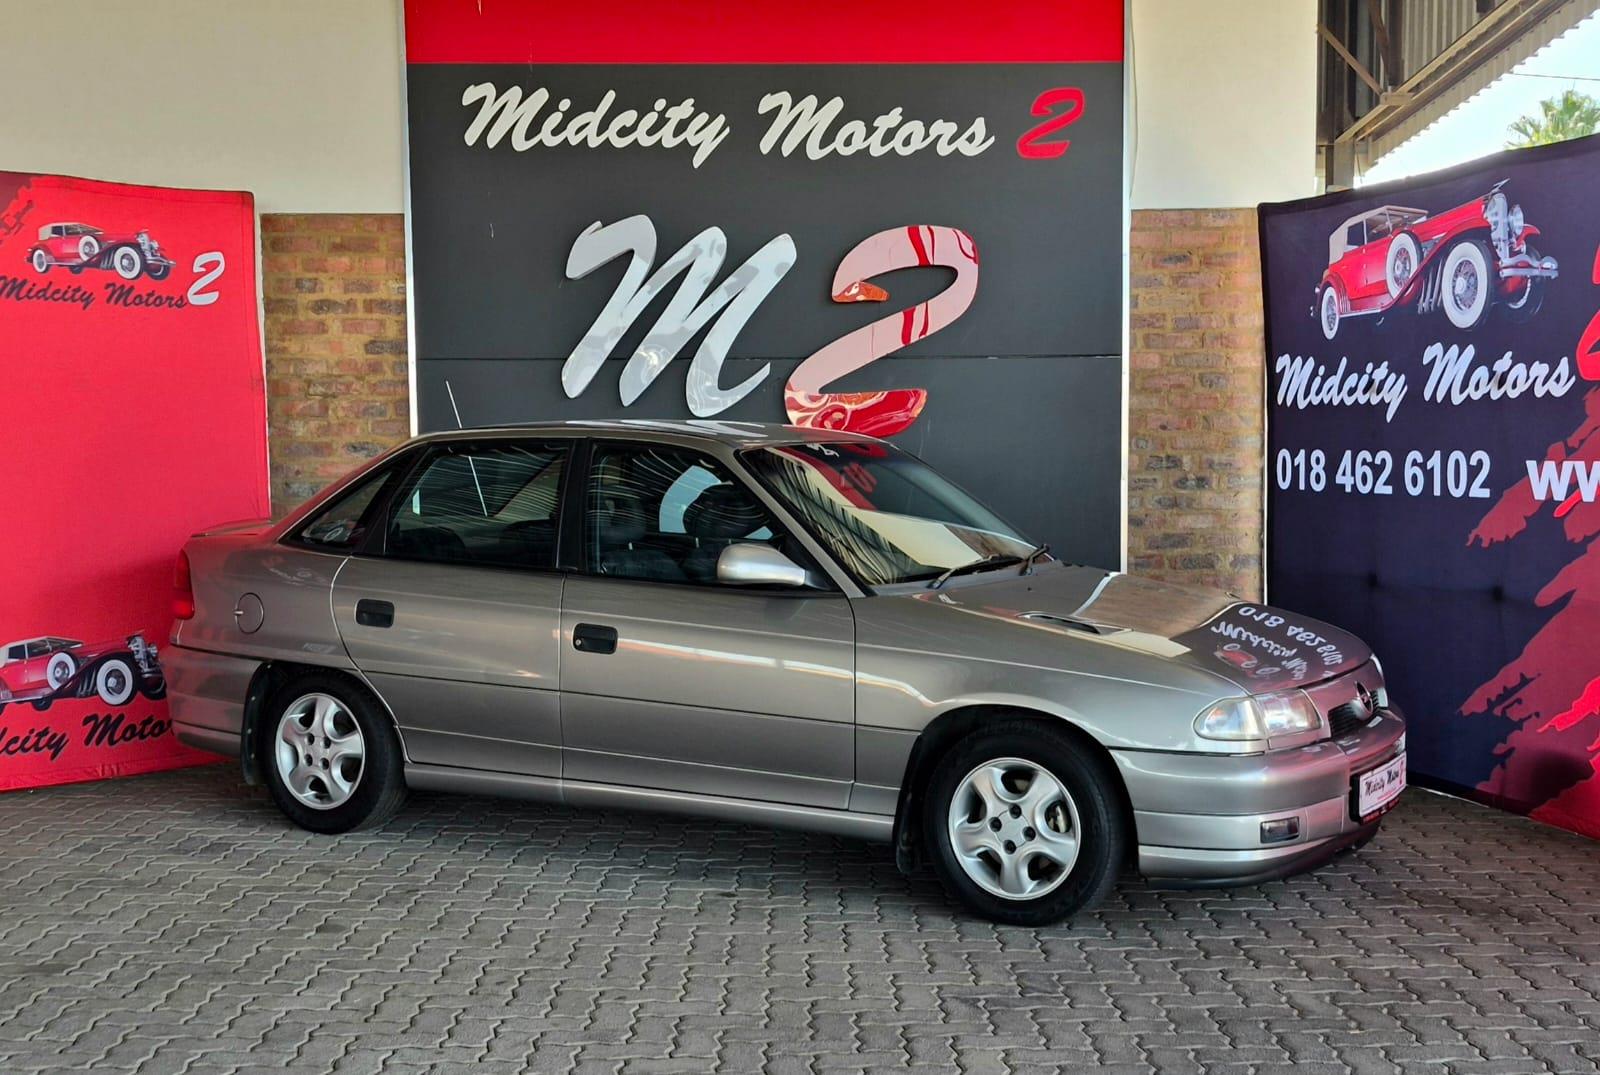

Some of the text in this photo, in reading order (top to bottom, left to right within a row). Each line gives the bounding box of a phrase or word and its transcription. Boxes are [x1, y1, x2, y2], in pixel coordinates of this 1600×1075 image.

[461, 82, 1085, 169] Midcity Motors 2
[0, 251, 226, 311] Midcity Motors 2
[1275, 341, 1576, 424] Midcity Motors
[1276, 448, 1327, 492] 018
[1335, 449, 1393, 495] 462
[1404, 449, 1491, 498] 6102
